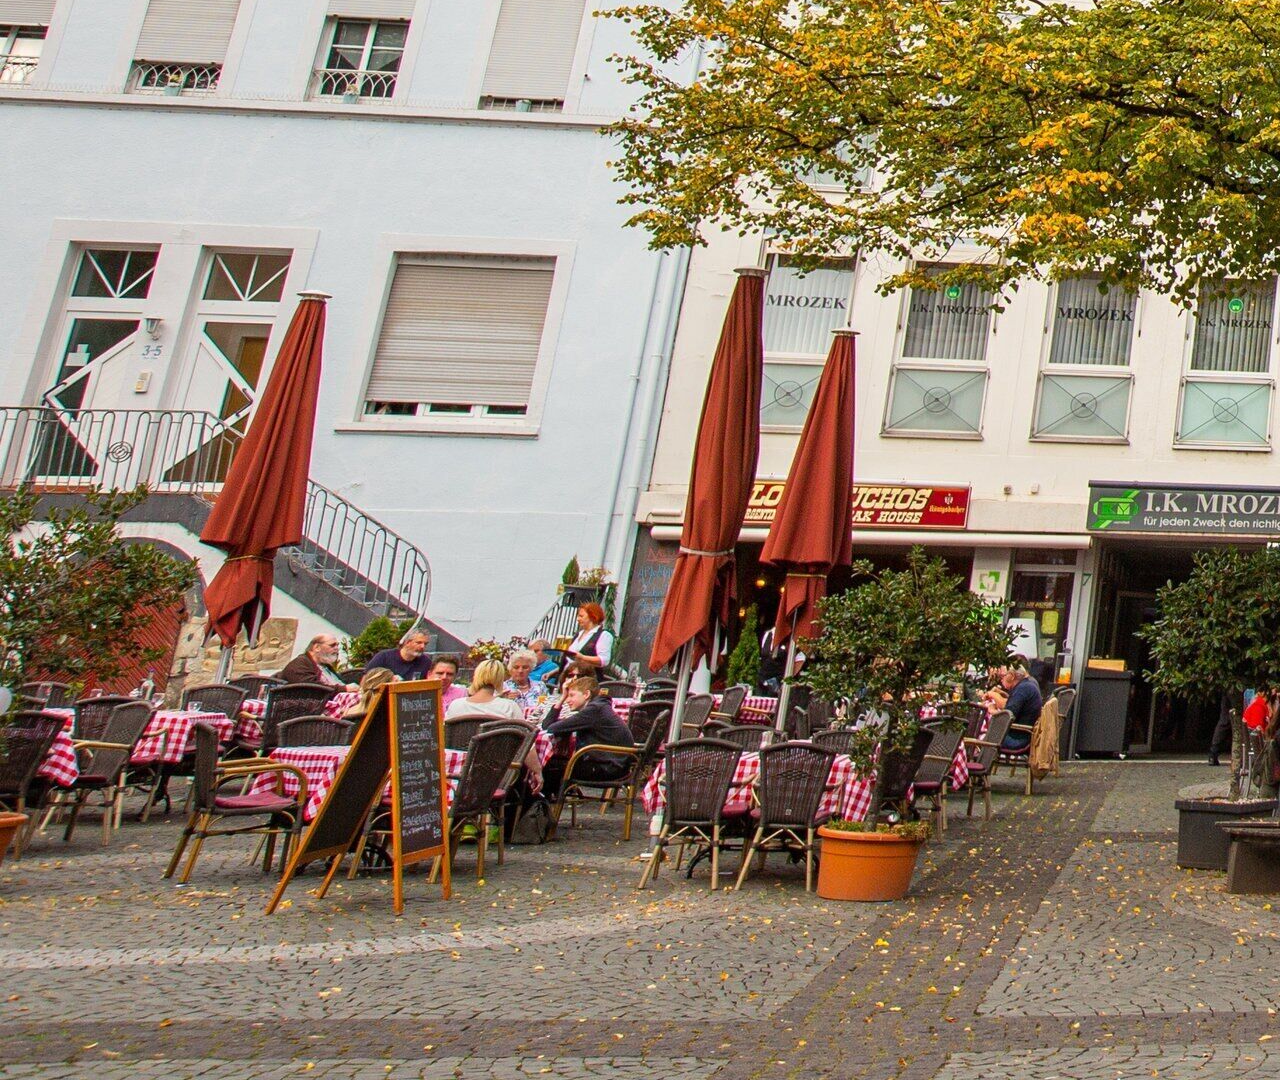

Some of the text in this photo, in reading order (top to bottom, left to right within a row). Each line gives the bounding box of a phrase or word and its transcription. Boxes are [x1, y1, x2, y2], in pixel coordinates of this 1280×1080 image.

[766, 294, 847, 309] MROZEK
[912, 303, 990, 316] I.K. MROZEK
[1057, 307, 1134, 321] MROZEK
[1200, 318, 1272, 330] .K. MROZEK
[142, 344, 163, 356] 3-5
[748, 484, 933, 510] LO UCHOS
[1144, 492, 1188, 513] I.K.
[877, 511, 923, 523] HOUSE
[1143, 516, 1157, 526] für
[1159, 517, 1191, 527] jeden
[1193, 517, 1226, 527] Zweck
[1229, 518, 1250, 528] den
[1082, 573, 1091, 586] 7
